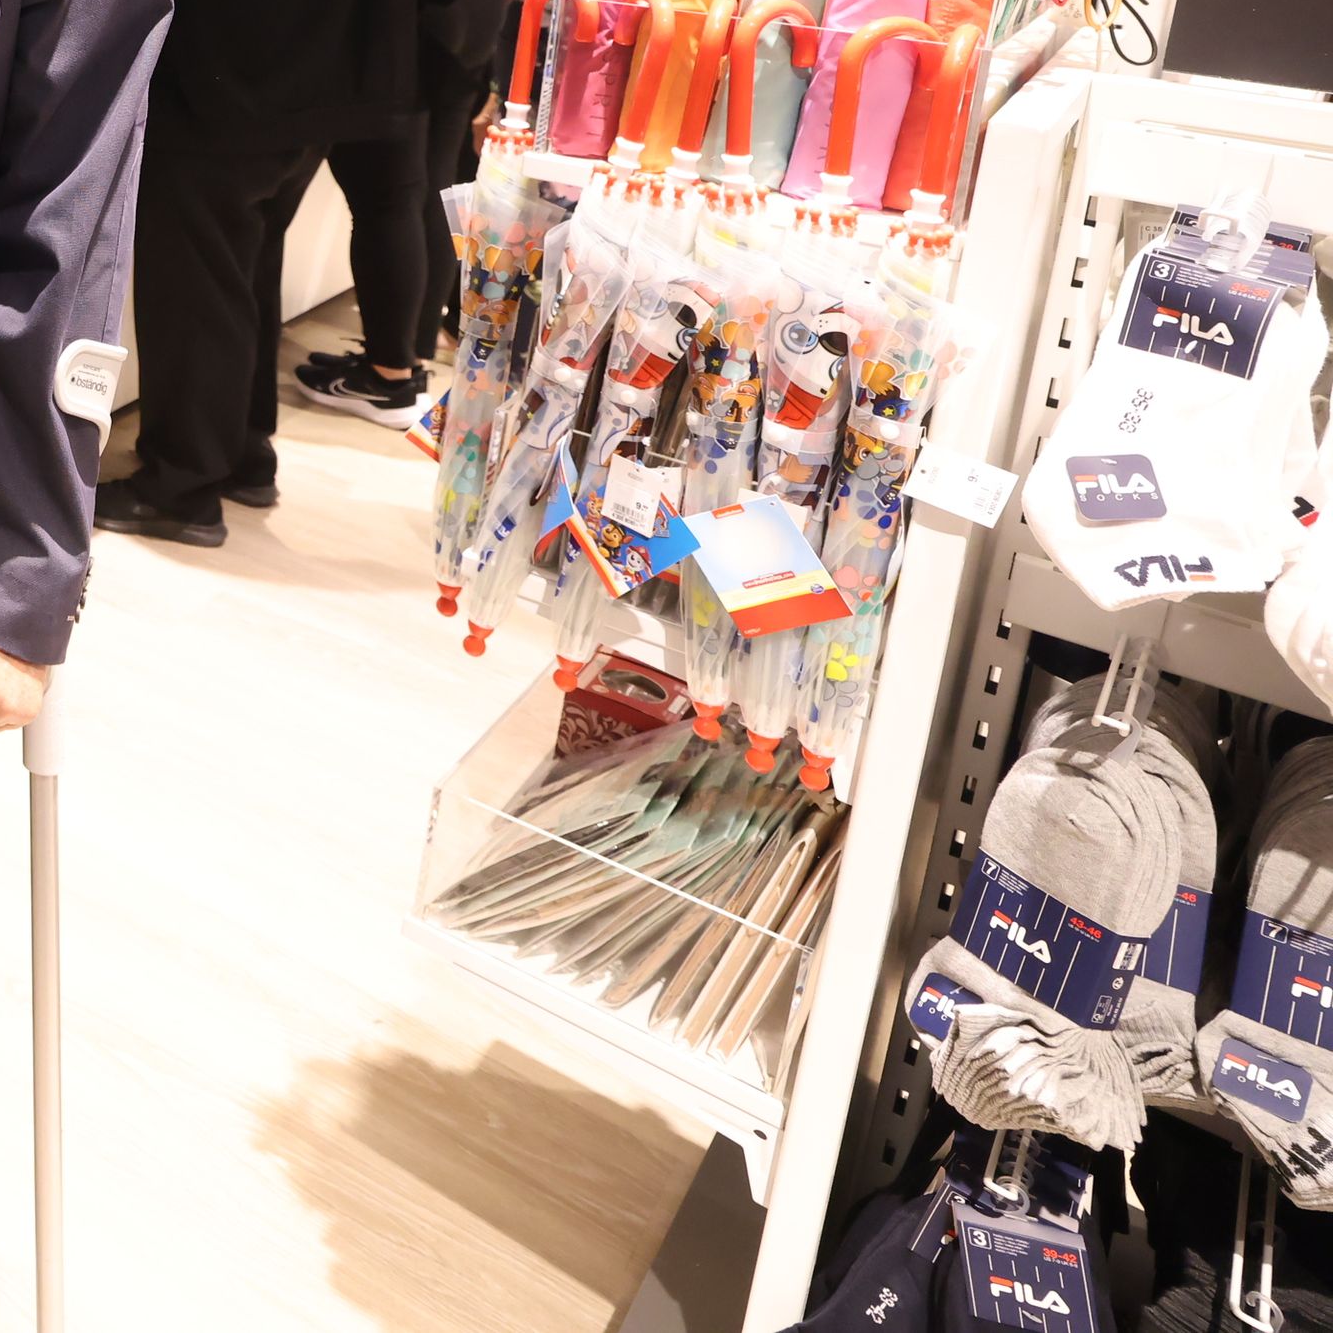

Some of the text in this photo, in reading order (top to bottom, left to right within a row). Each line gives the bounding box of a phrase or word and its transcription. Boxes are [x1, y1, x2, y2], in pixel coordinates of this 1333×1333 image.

[1153, 263, 1171, 278] 3
[1152, 306, 1235, 346] FILA
[1073, 472, 1156, 495] FILA
[1078, 492, 1159, 502] SOCKS
[1114, 554, 1217, 587] FILA
[985, 860, 998, 876] 7
[990, 909, 1052, 964] FILA
[1069, 916, 1103, 939] 43-46
[1268, 923, 1283, 939] 7
[917, 1000, 948, 1021] SOC
[920, 986, 955, 1020] FIL
[1220, 1067, 1300, 1107] SOCKS
[1223, 1053, 1302, 1101] FILA
[972, 1230, 986, 1246] 3
[1043, 1247, 1078, 1264] 39-42
[989, 1275, 1071, 1315] FILA
